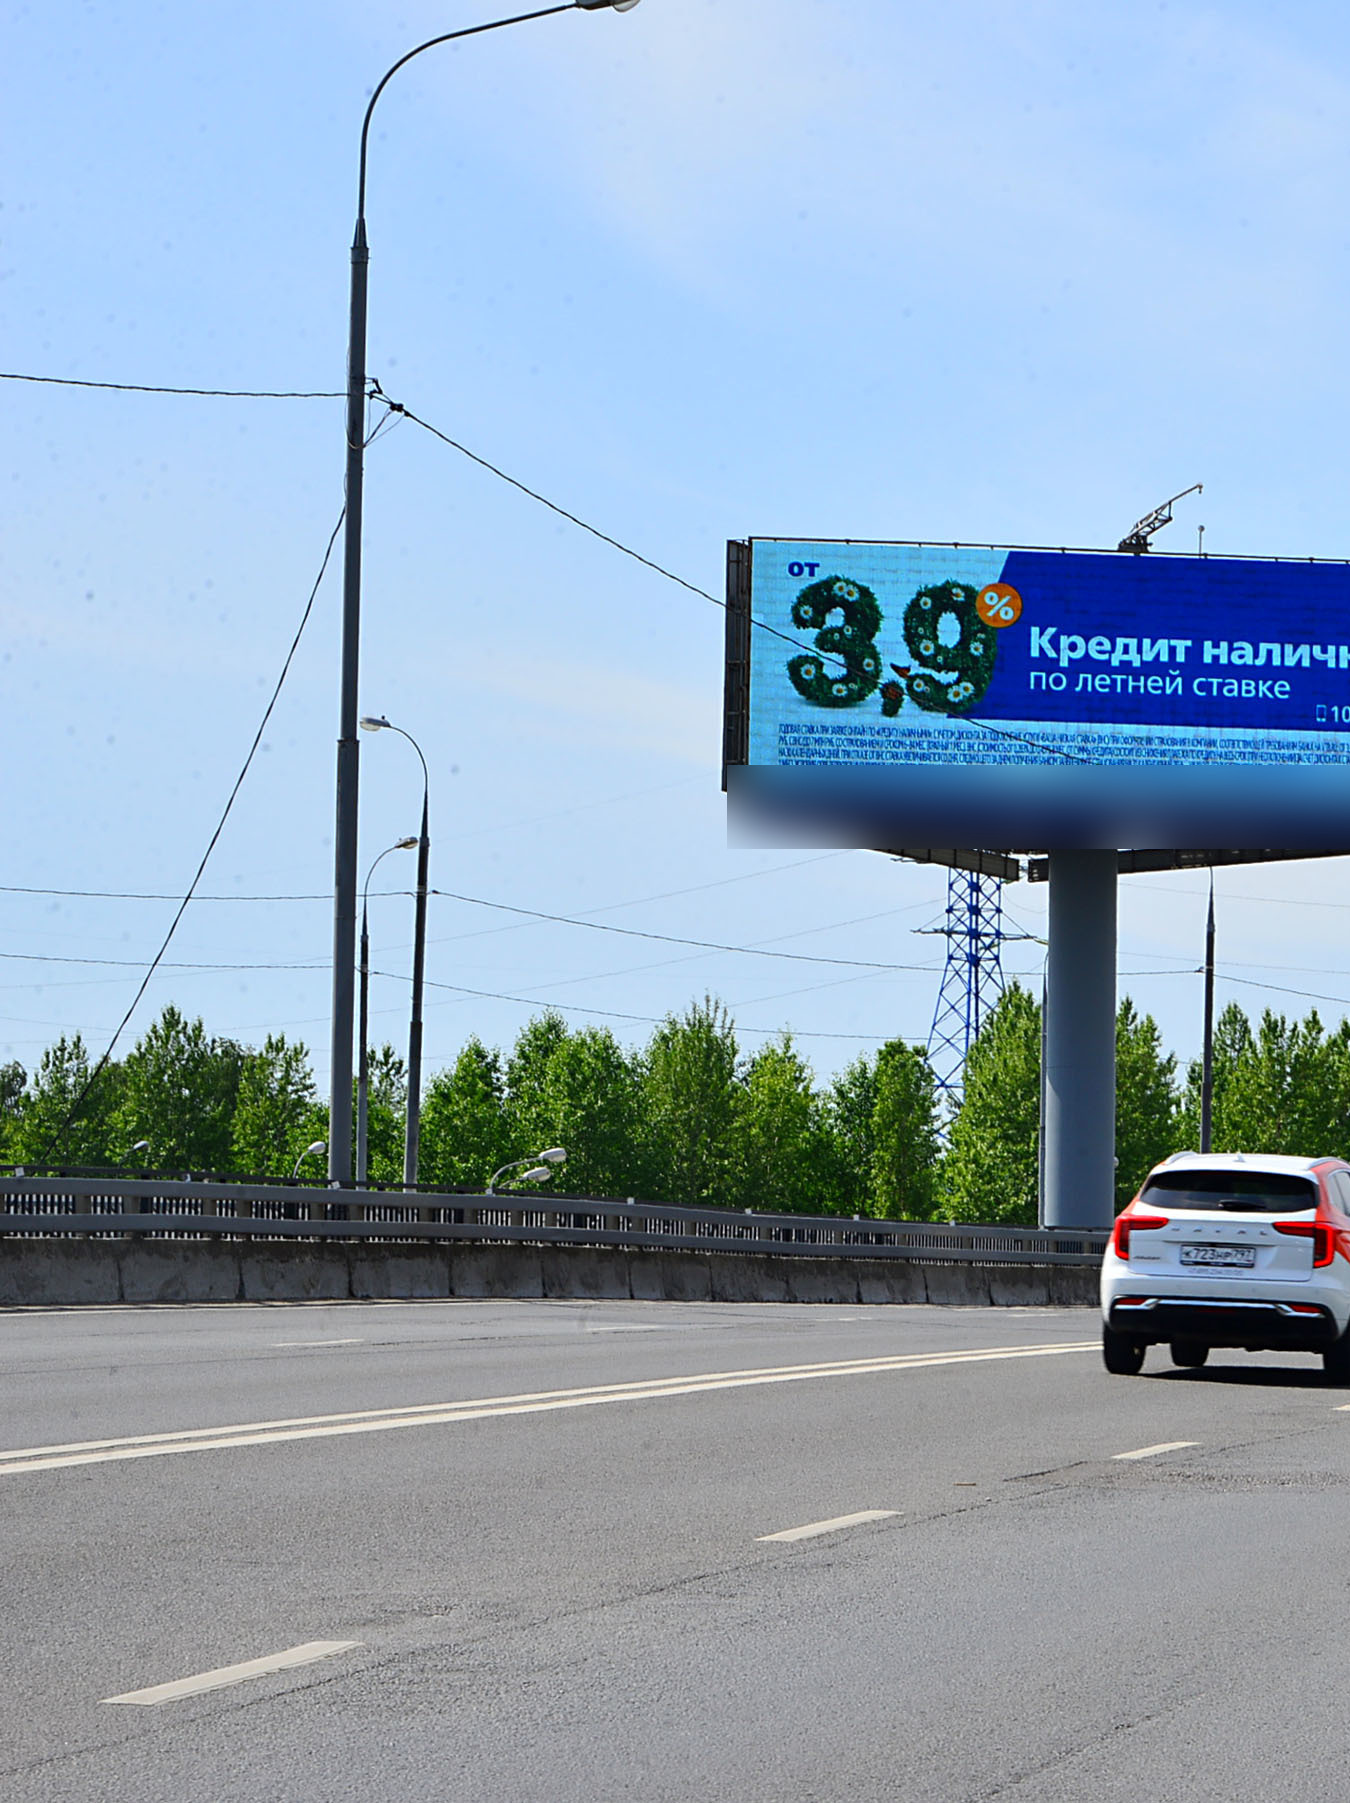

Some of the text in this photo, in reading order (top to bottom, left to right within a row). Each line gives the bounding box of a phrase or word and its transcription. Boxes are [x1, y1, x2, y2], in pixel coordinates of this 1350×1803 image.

[1030, 626, 1192, 667] Кредит
[1030, 669, 1291, 699] по летней ставке
